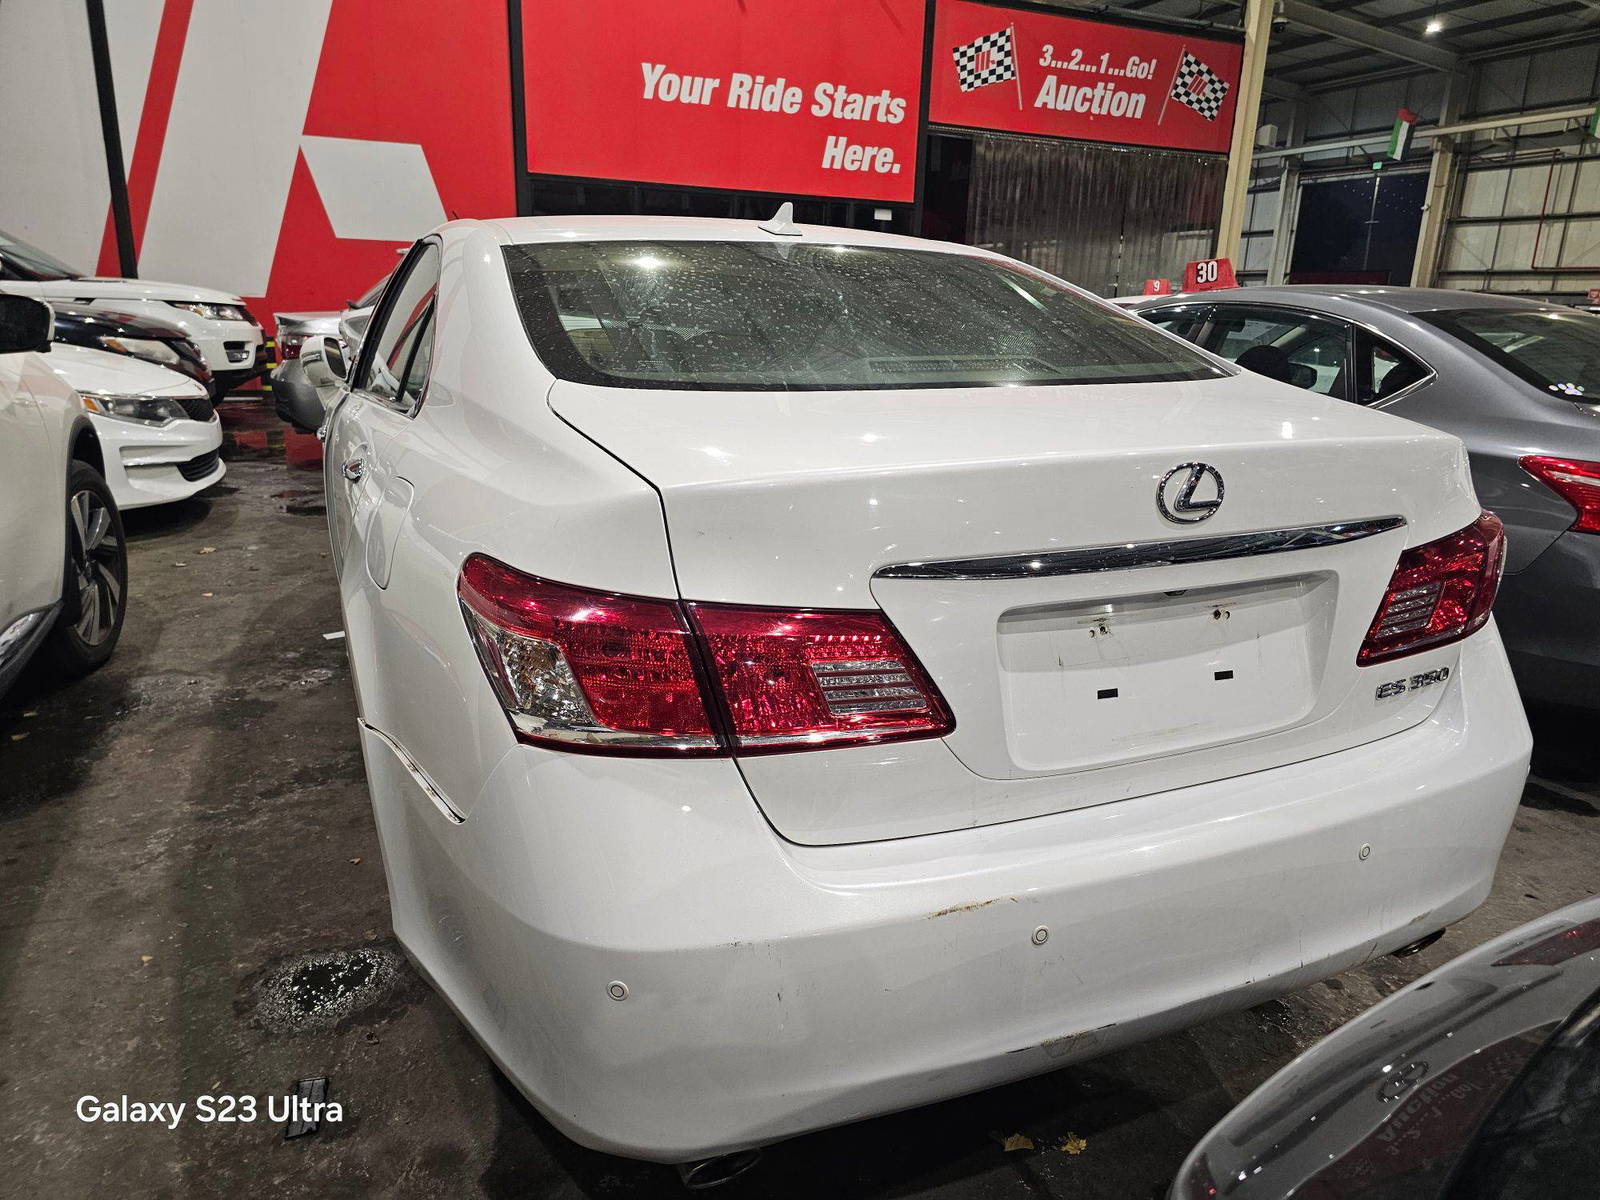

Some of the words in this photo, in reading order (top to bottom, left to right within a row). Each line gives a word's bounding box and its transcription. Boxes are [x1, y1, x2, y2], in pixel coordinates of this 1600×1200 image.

[641, 62, 720, 105] Your
[727, 73, 803, 114] Ride
[810, 82, 906, 124] Starts
[1034, 75, 1146, 118] Auction
[821, 135, 901, 174] Here.
[1152, 280, 1161, 292] 9
[1196, 260, 1218, 283] 30
[1375, 679, 1406, 701] ES
[1408, 667, 1450, 691] 350
